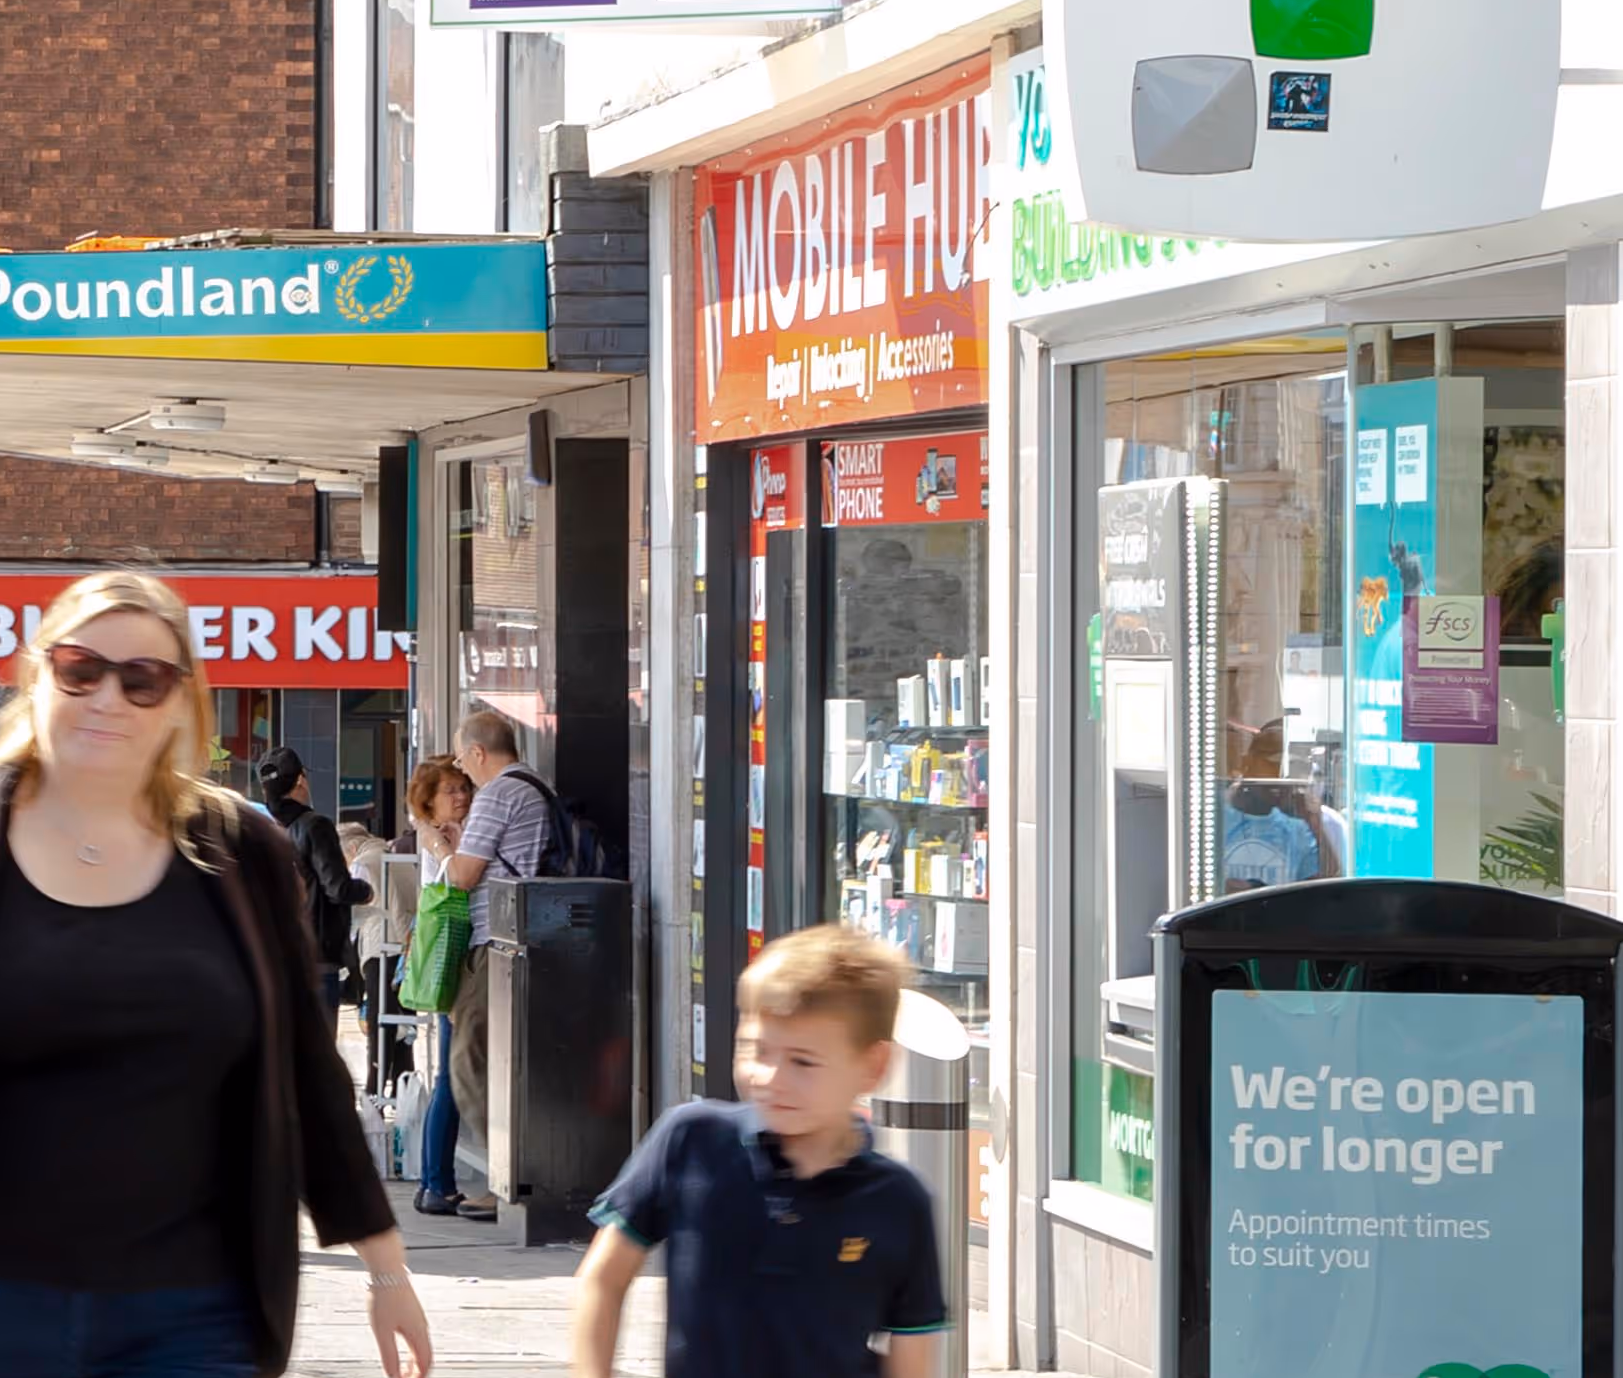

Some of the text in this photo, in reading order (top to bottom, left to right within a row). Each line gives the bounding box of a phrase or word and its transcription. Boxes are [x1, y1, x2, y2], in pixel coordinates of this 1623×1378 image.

[731, 90, 990, 338] MOBILE HUB
[766, 349, 802, 409] Repair
[877, 319, 954, 381] Accessories
[838, 443, 884, 477] SMART
[838, 487, 884, 519] PHONE
[1229, 1064, 1535, 1124] We're open
[1229, 1123, 1503, 1185] for longer
[1228, 1208, 1490, 1241] Appointment times
[1228, 1242, 1371, 1276] to suit you
